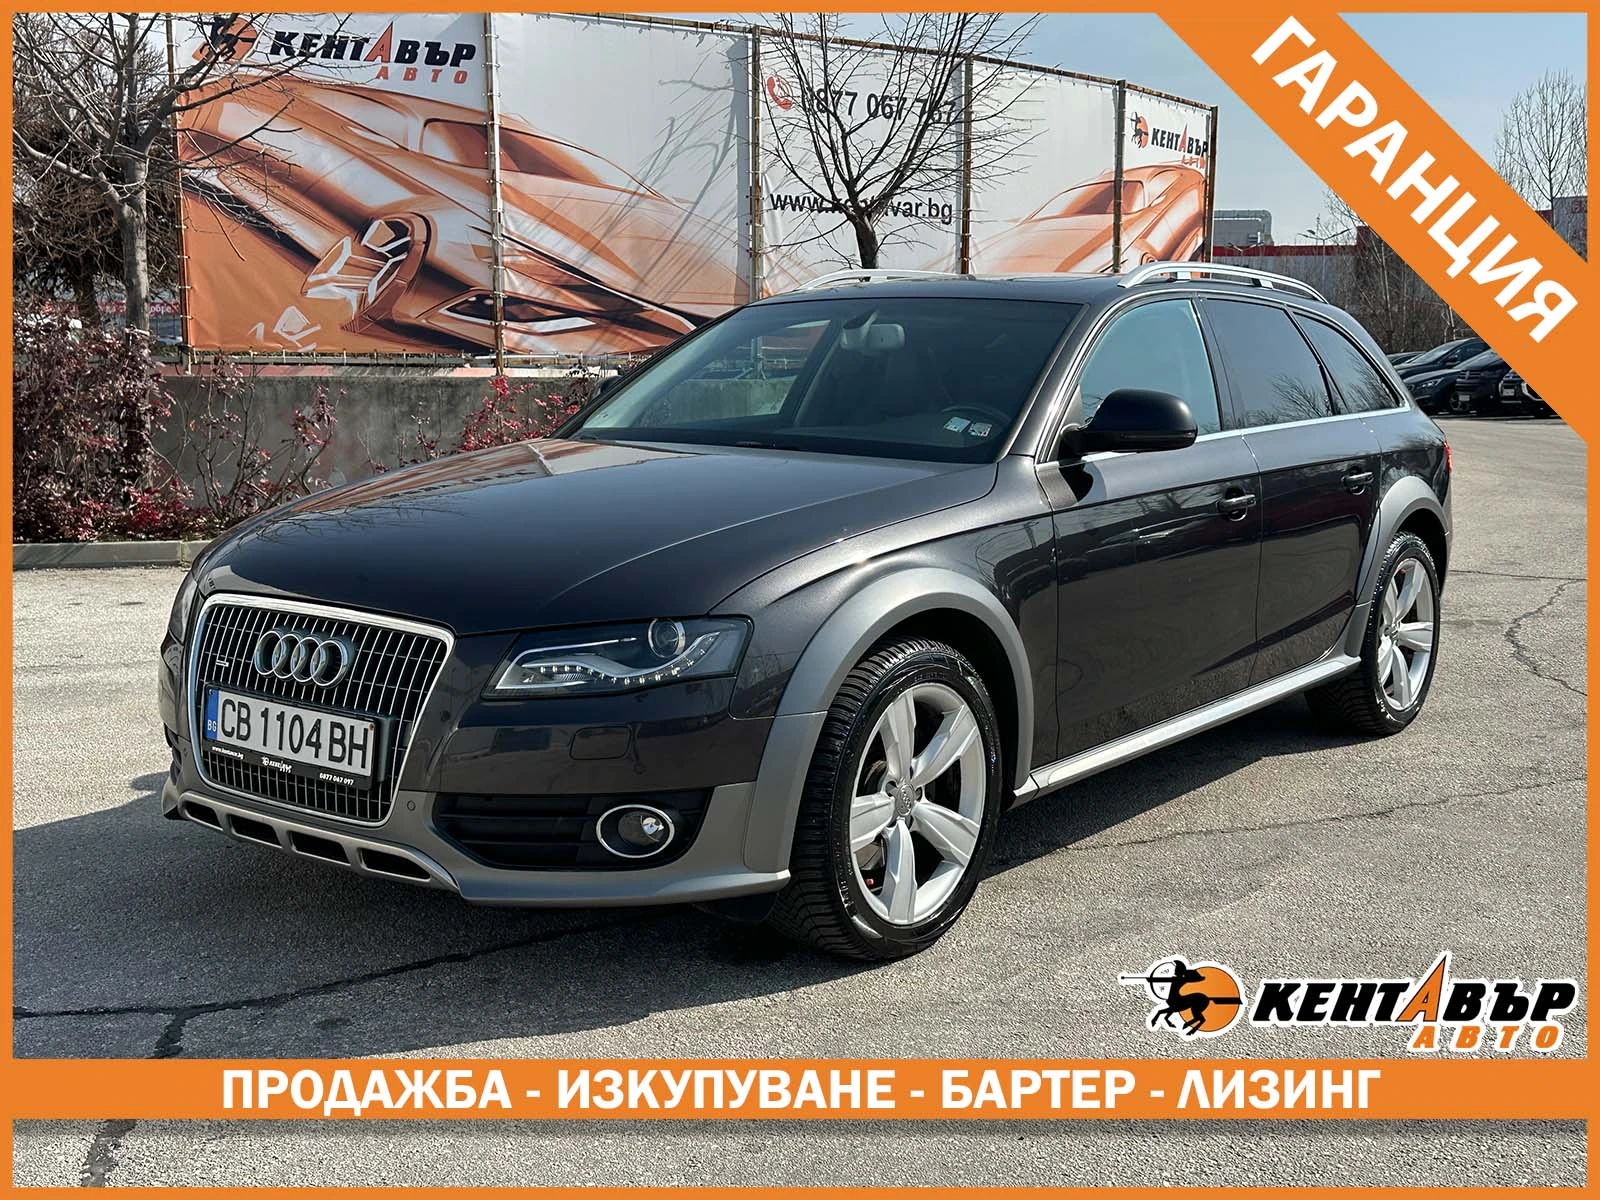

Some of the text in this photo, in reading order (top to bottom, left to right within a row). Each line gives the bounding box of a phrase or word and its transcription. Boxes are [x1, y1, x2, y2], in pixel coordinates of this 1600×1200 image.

[268, 21, 476, 67] КЕНТАВЪР
[375, 65, 468, 84] АВТО
[866, 92, 907, 121] 067
[1151, 123, 1208, 157] КЕНТАВЪР
[207, 719, 217, 732] BG
[221, 698, 367, 770] CB 1104 BH
